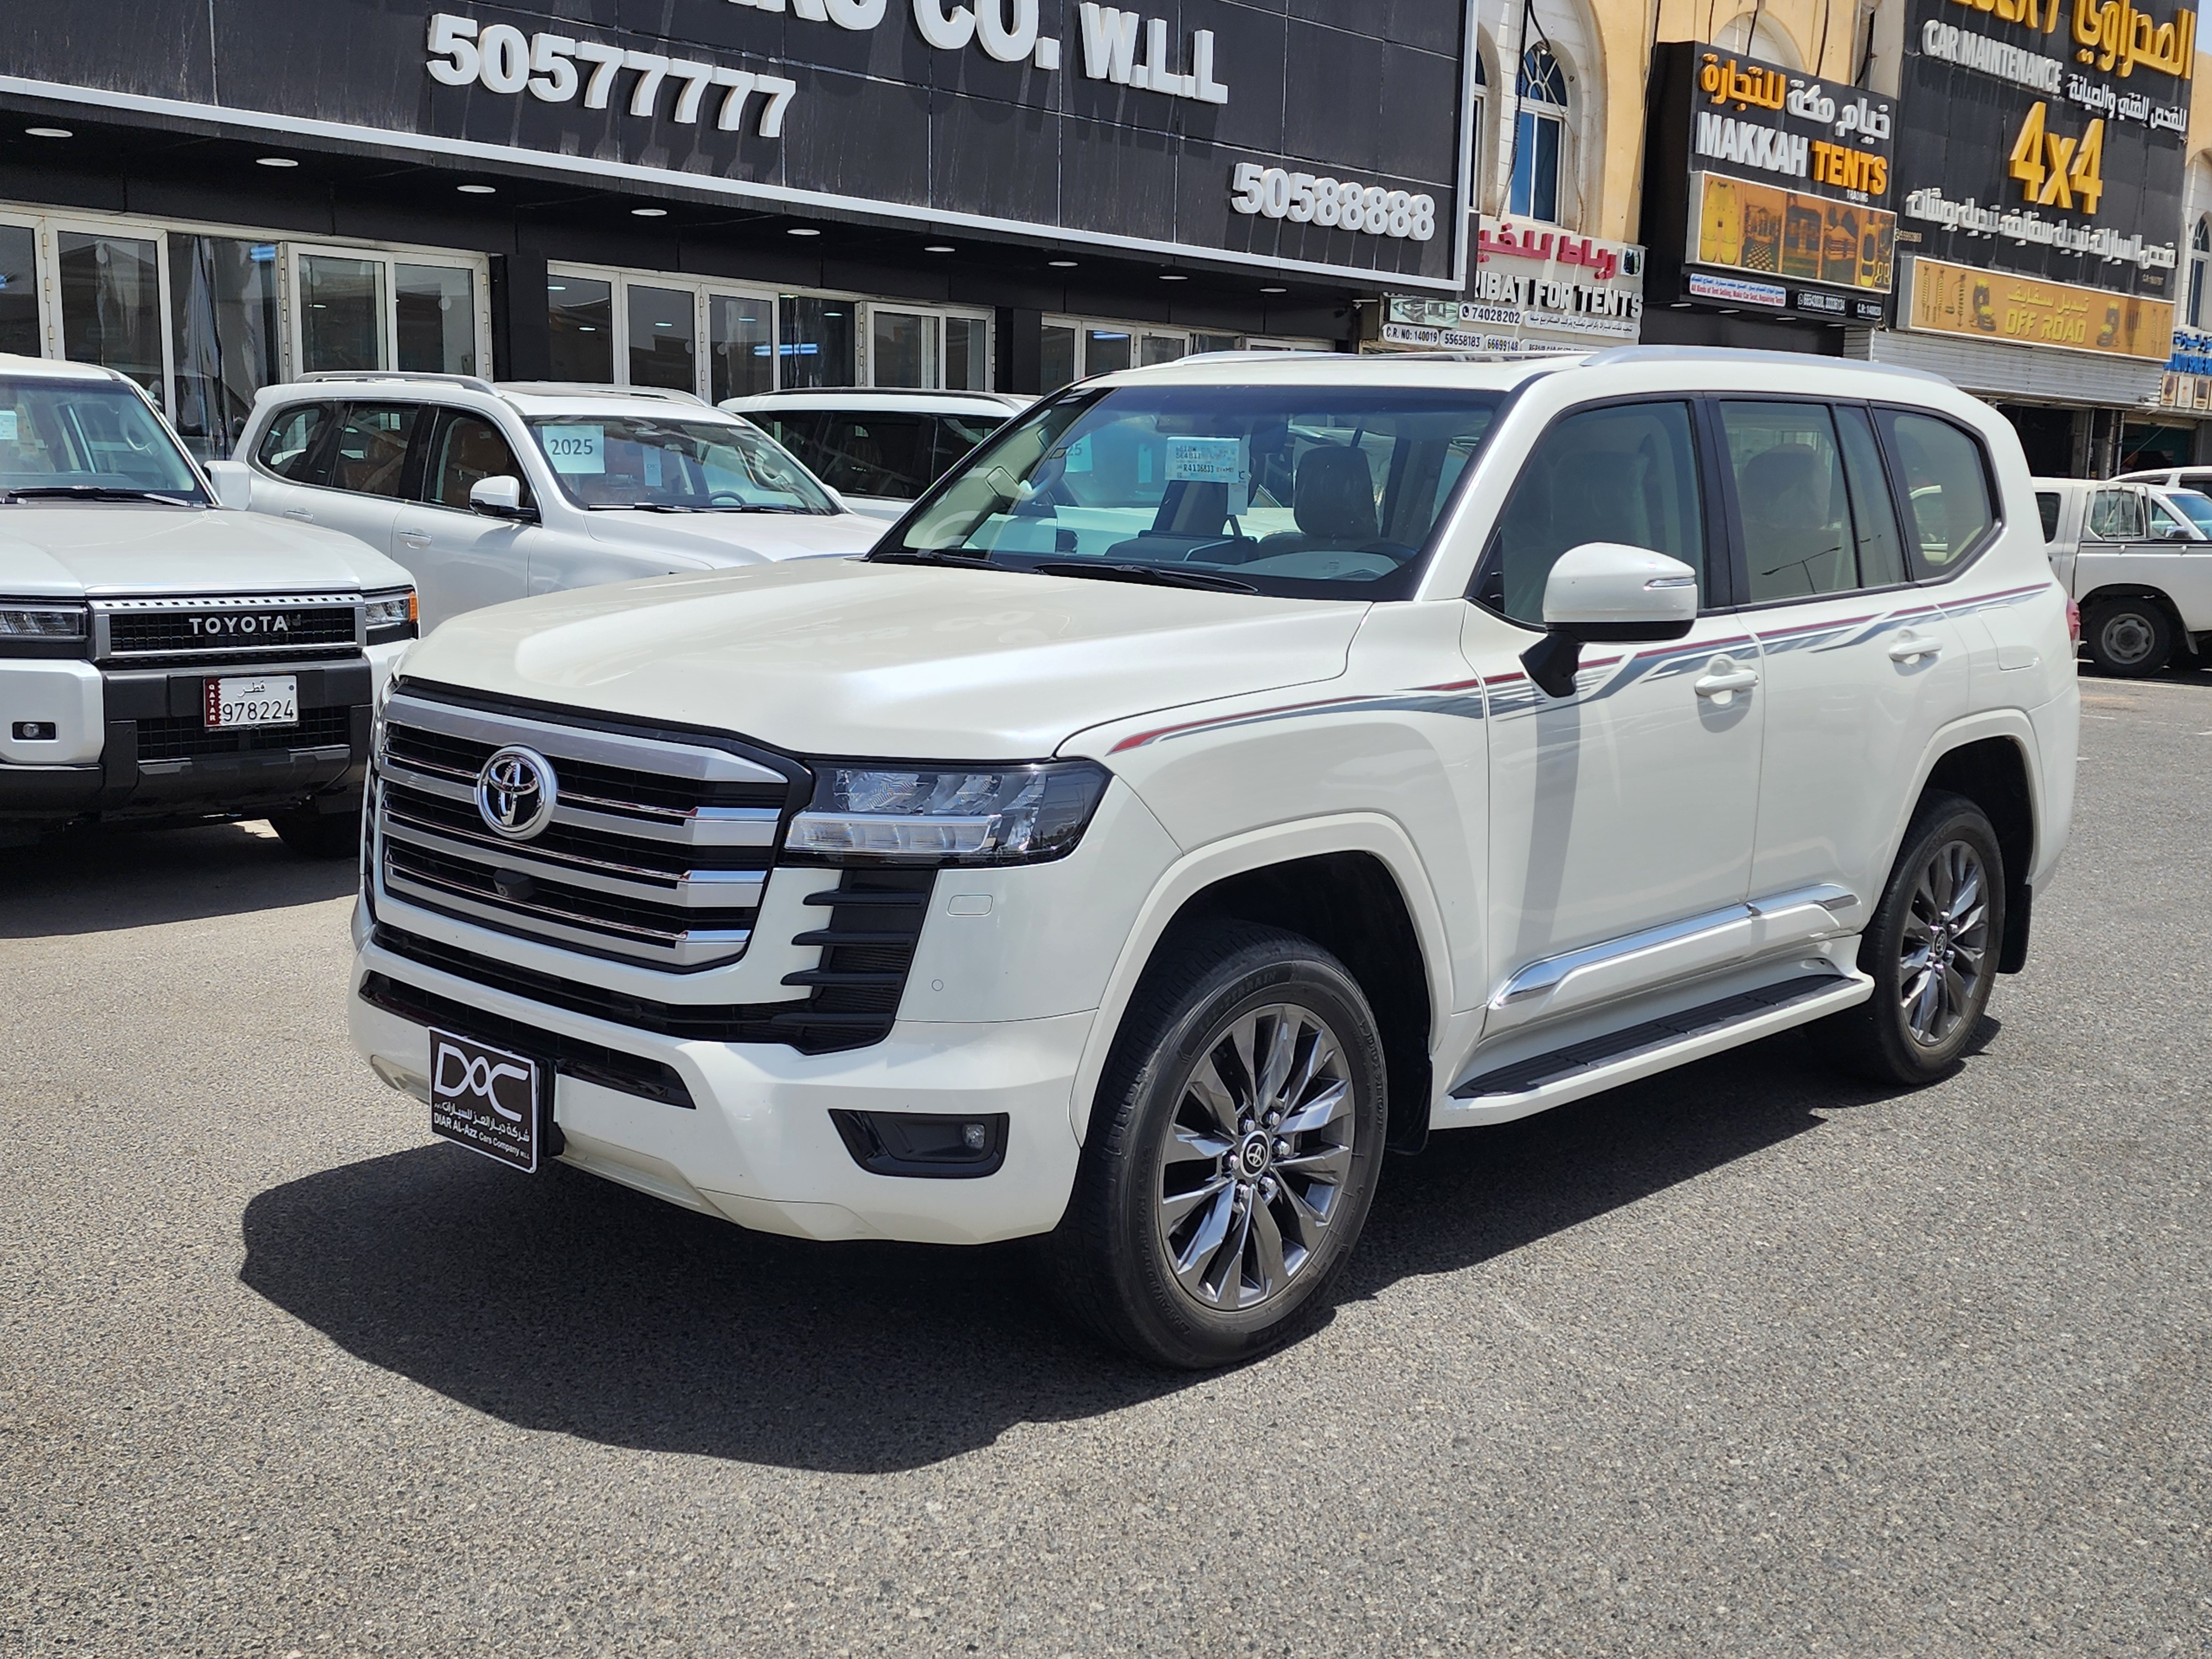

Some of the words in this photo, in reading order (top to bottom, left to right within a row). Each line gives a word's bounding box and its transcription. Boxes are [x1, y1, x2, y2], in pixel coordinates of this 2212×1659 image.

[426, 13, 796, 138] 50577777
[1922, 19, 1959, 64] CAR
[1959, 29, 2063, 94] MAINTENANCE
[1700, 53, 1786, 111] للتجارة
[1786, 79, 1835, 123] مكة
[1835, 97, 1890, 144] خيام
[1695, 111, 1809, 178] MAKKAH
[1812, 139, 1888, 195] TENTS
[1231, 161, 1436, 241] 50588888
[1556, 234, 1616, 280] رباط
[1472, 307, 1520, 324] 74028202
[1534, 279, 1574, 310] FOR
[1579, 285, 1644, 319] TENTS
[1386, 326, 1400, 338] C.R.
[1401, 329, 1412, 341] NO:
[1414, 331, 1437, 342] 140019
[1444, 333, 1480, 348] 55658183
[2005, 307, 2038, 336] OFF
[2041, 313, 2087, 345] ROAD
[551, 439, 593, 456] 2025
[189, 615, 288, 634] TOYOTA
[237, 680, 266, 697] قطر
[222, 699, 294, 723] 978224
[442, 1101, 473, 1120] للسيارات
[489, 1118, 505, 1135] ديار
[434, 1112, 452, 1129] DIAR
[478, 1131, 492, 1145] Cars
[493, 1137, 520, 1157] Company
[507, 1123, 530, 1142] شركة
